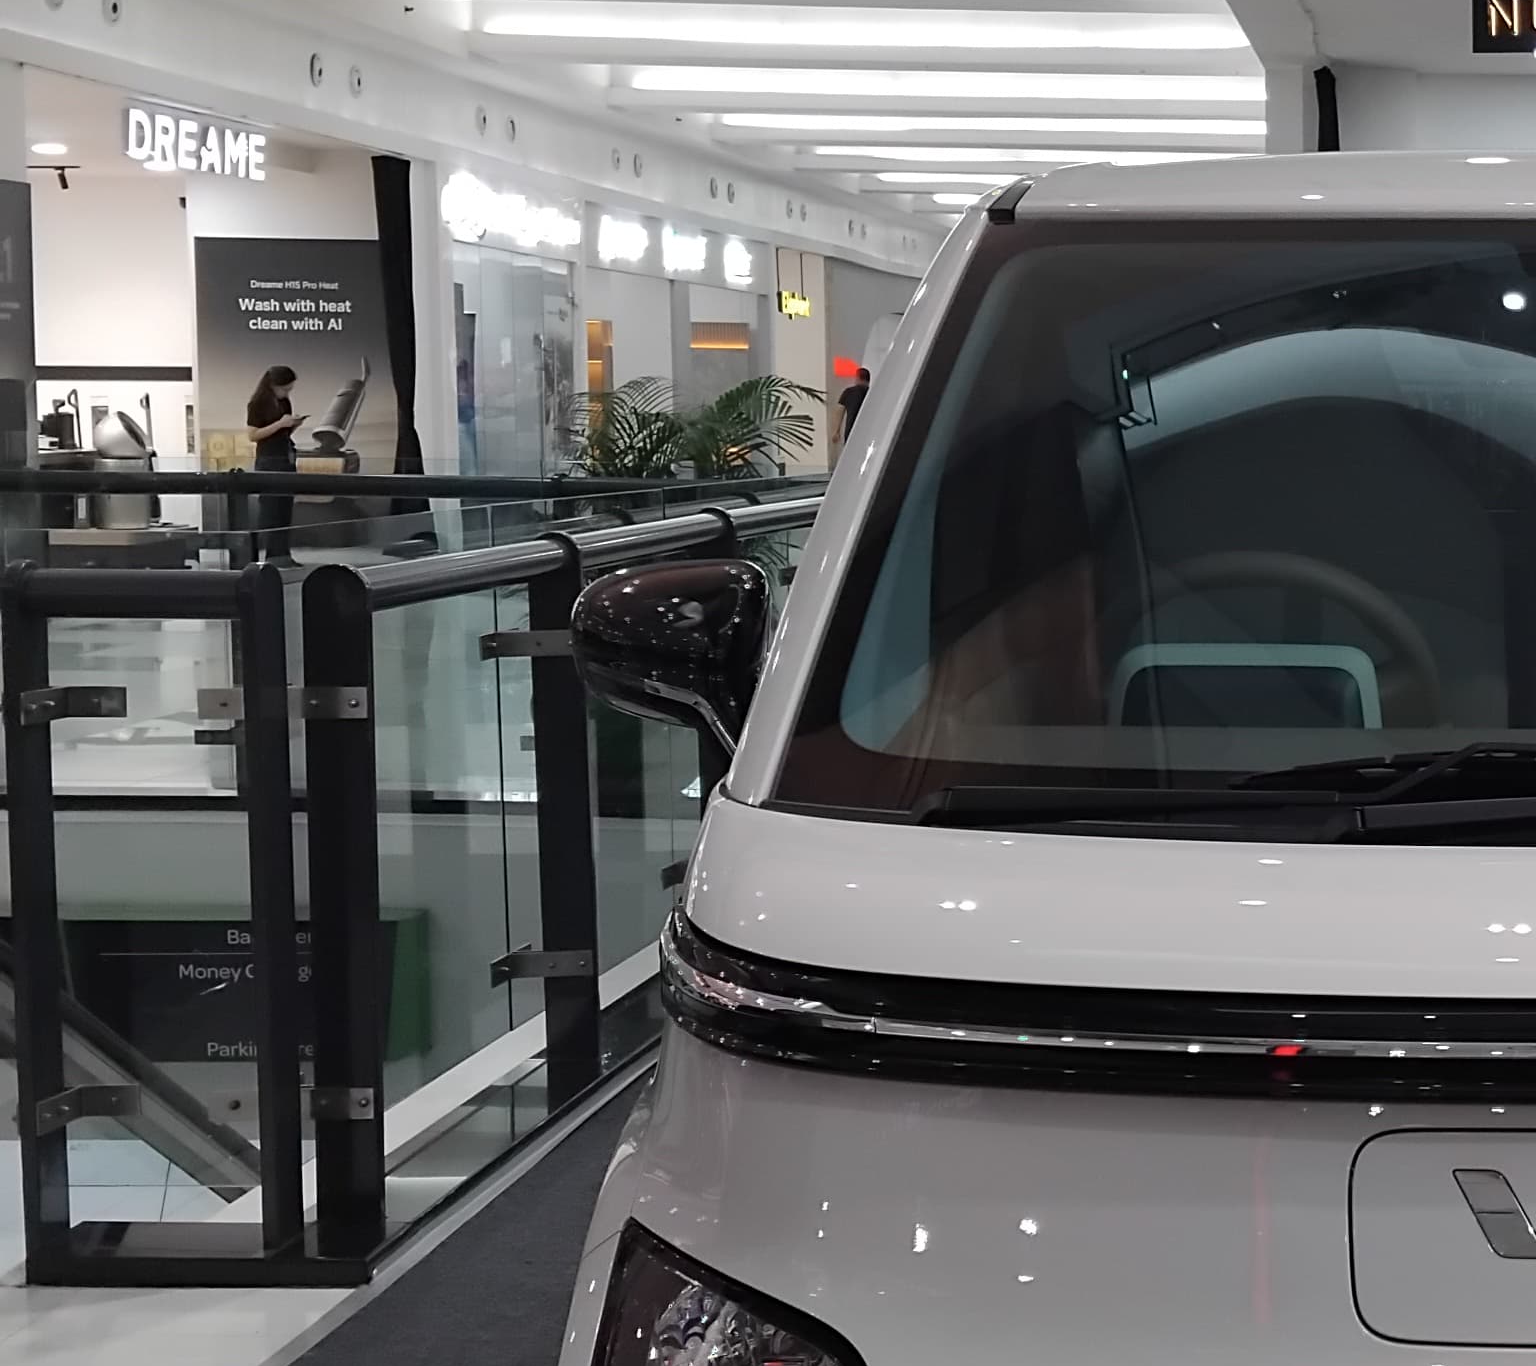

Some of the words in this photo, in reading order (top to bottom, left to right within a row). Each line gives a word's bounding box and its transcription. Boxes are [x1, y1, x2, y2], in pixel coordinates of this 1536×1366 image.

[127, 108, 266, 181] DREAME
[238, 298, 280, 312] Wash
[283, 299, 316, 312] with
[319, 300, 352, 313] heat
[248, 317, 288, 330] clean
[291, 318, 324, 331] with
[327, 318, 343, 331] AI
[178, 963, 242, 983] Money
